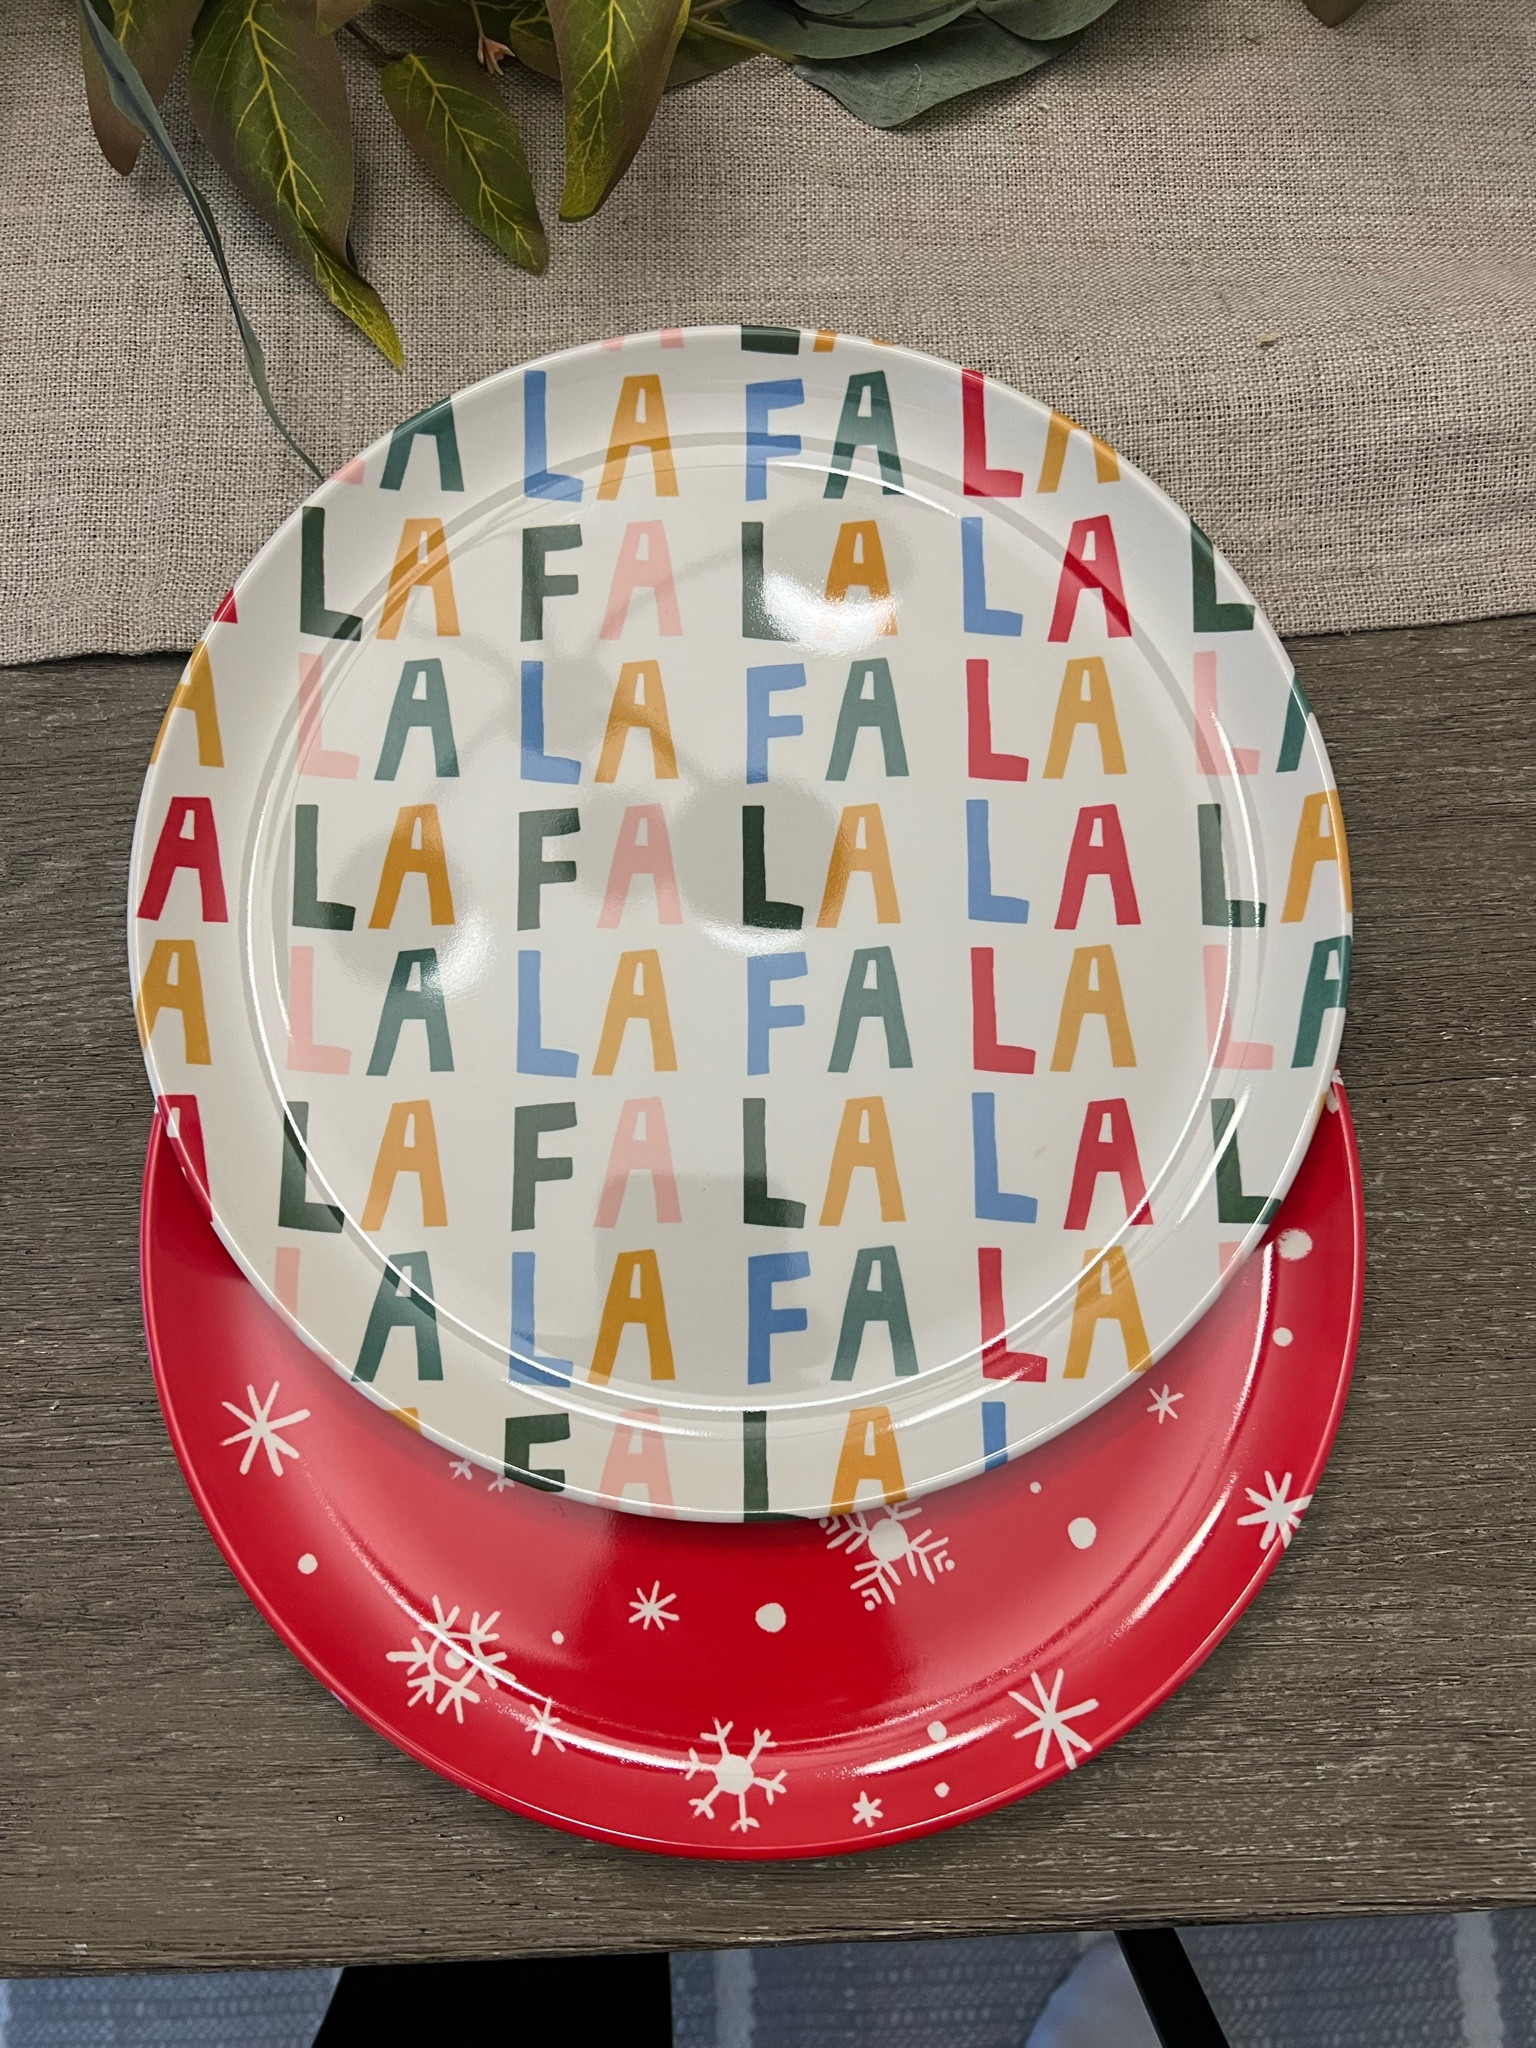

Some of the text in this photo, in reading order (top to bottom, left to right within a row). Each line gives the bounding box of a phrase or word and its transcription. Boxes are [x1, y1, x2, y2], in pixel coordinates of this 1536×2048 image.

[524, 371, 679, 502] LA
[746, 371, 904, 501] FA
[301, 506, 460, 641] LA
[521, 520, 683, 641] FA
[742, 520, 897, 641] LA
[961, 515, 1131, 642] LA
[299, 654, 459, 781] LA
[521, 660, 679, 785] LA
[746, 657, 909, 784] FA
[967, 657, 1126, 782] LA
[135, 789, 1352, 931] A LA FA LA LA LA
[137, 940, 211, 1065] A
[287, 946, 454, 1076] LA
[517, 949, 678, 1078] LA
[747, 946, 913, 1075] FA
[971, 945, 1137, 1074] LA
[278, 1100, 447, 1234] LA
[511, 1096, 682, 1232] FA
[743, 1096, 906, 1229] LA
[972, 1092, 1153, 1230] LA
[508, 1249, 675, 1387] LA
[747, 1246, 920, 1385] FA
[978, 1246, 1153, 1383] LA
